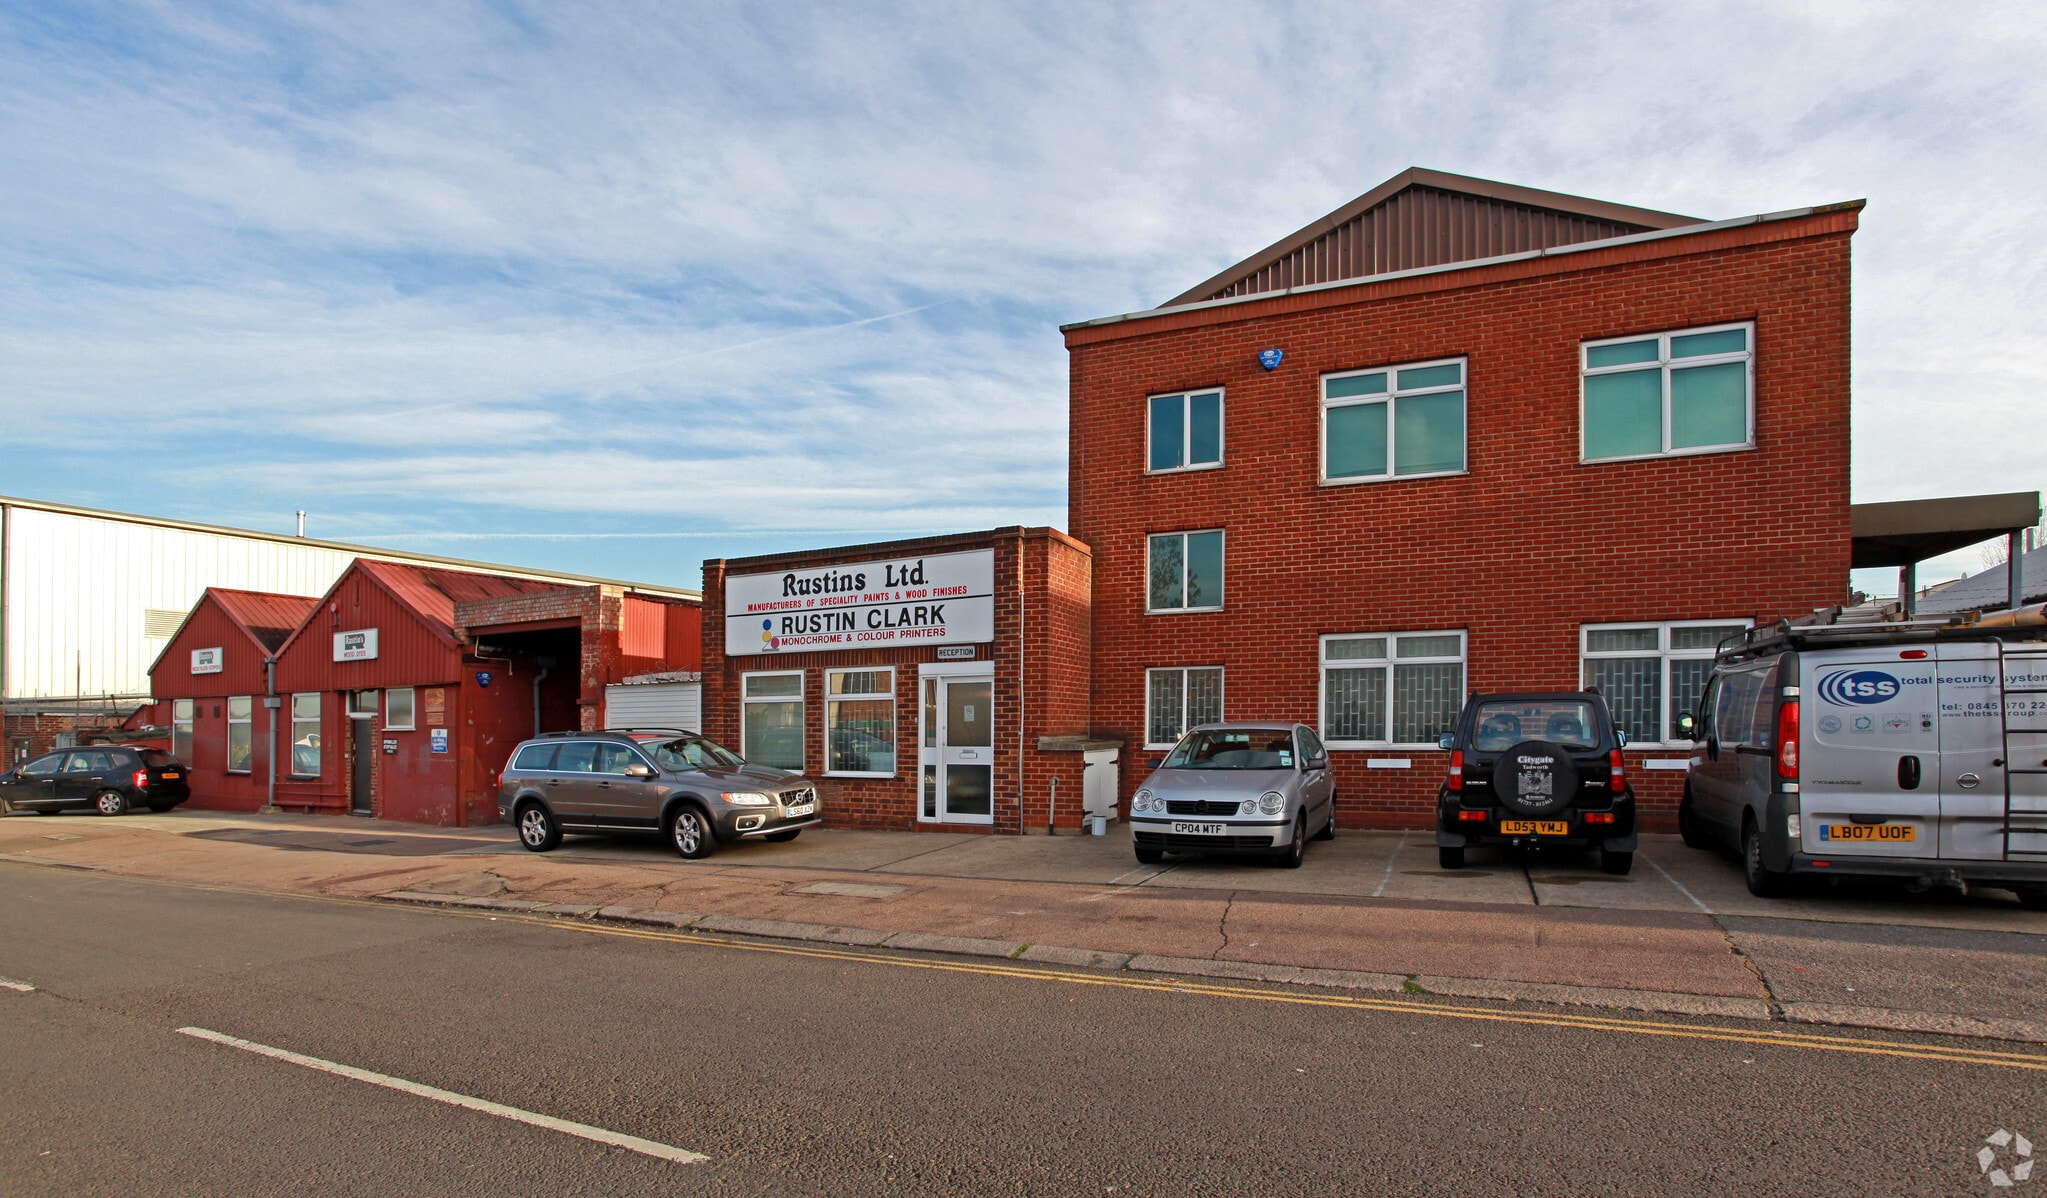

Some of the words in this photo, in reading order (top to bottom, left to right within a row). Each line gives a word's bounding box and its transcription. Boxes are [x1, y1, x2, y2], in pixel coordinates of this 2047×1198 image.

[782, 570, 866, 597] Rustins
[885, 559, 929, 587] Ltd.
[747, 600, 802, 611] MANUFACTURERS
[807, 598, 815, 607] OF
[820, 595, 858, 606] SPECIALITY
[864, 592, 889, 602] PAINTS
[905, 589, 927, 599] WOOD
[933, 585, 967, 596] FINISHES
[782, 611, 855, 634] RUSTIN
[867, 604, 945, 629] CLARK
[781, 634, 842, 646] MONOCHROME
[846, 634, 852, 642] &
[857, 631, 894, 641] COLOUR
[900, 628, 946, 638] PRINTERS
[939, 648, 974, 657] RECEPTION
[1901, 676, 1932, 685] total
[1937, 674, 1996, 684] security
[1842, 678, 1896, 697] tss
[1942, 703, 1962, 711] tel:
[1967, 702, 1998, 710] 0845
[2031, 701, 2047, 709] 22
[1517, 756, 1554, 764] Citygate
[1175, 823, 1200, 833] CP04
[1203, 824, 1222, 834] MTF
[1506, 821, 1536, 832] LD53
[1540, 822, 1563, 832] YMJ
[1830, 826, 1873, 838] LB07
[1879, 826, 1912, 838] UOF
